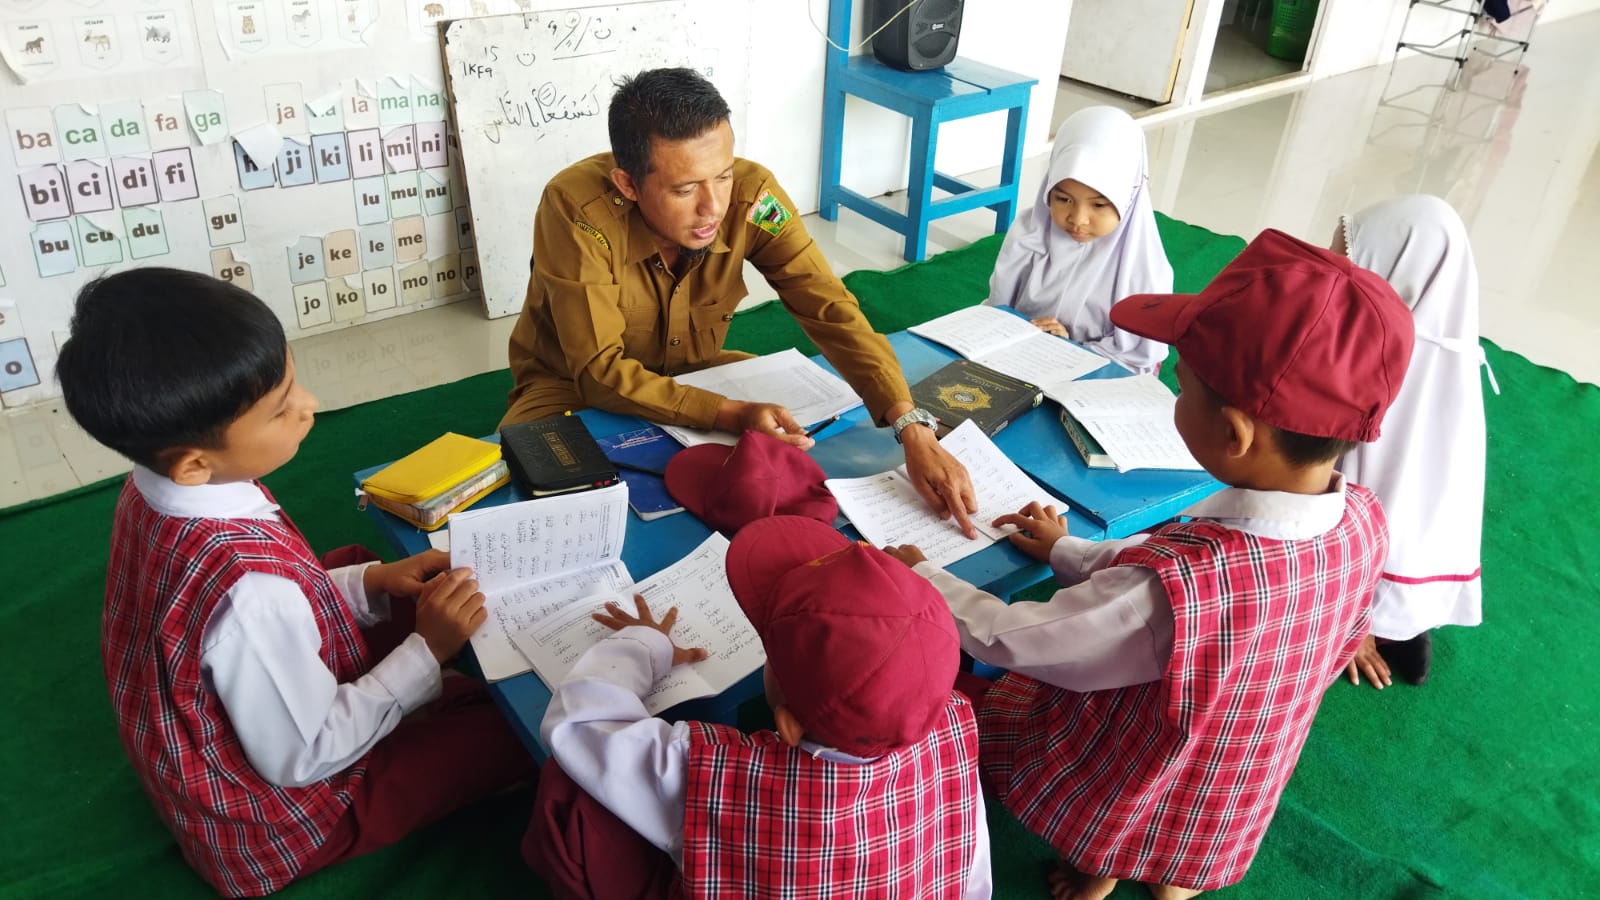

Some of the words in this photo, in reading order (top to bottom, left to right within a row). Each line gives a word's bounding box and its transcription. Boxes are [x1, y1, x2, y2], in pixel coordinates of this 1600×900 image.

[17, 130, 52, 149] ba
[66, 128, 97, 144] ca
[111, 119, 139, 137] da
[155, 114, 177, 131] fa
[194, 112, 222, 132] ga
[277, 104, 295, 124] ja
[352, 97, 368, 113] la
[381, 96, 408, 109] ma
[418, 94, 440, 107] na
[30, 180, 59, 204] bi
[78, 173, 101, 196] ci
[123, 167, 147, 189] di
[165, 163, 185, 184] fi
[286, 150, 301, 175] ji
[321, 146, 341, 166] ki
[359, 143, 372, 161] li
[386, 136, 412, 157] mi
[422, 133, 440, 152] ni
[39, 240, 69, 254] bu
[86, 231, 113, 243] cu
[132, 223, 159, 237] du
[211, 214, 237, 230] gu
[363, 194, 379, 205] lu
[391, 188, 417, 200] mu
[425, 185, 447, 198] nu
[299, 253, 314, 269] je
[330, 249, 351, 261] ke
[370, 240, 384, 252] le
[398, 234, 422, 246] me
[304, 297, 320, 315] jo
[336, 292, 358, 305] ko
[372, 283, 387, 295] lo
[403, 276, 428, 289] mo
[437, 269, 456, 283] no
